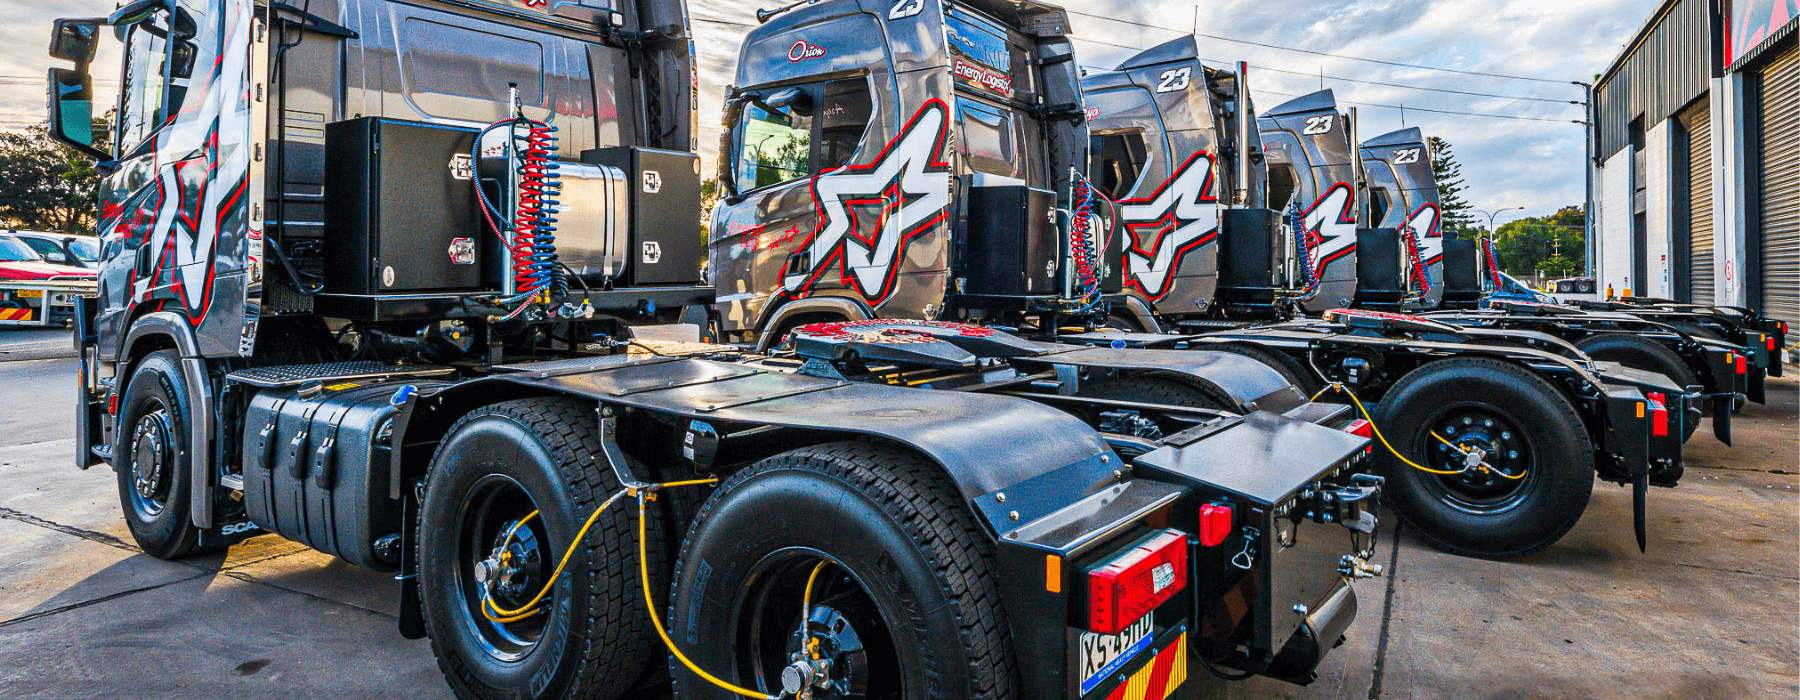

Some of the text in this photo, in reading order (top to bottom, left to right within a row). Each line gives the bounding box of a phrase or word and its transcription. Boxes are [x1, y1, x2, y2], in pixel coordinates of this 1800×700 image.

[888, 0, 924, 20] 23
[788, 39, 827, 63] Orion
[1157, 67, 1192, 94] 23
[1303, 115, 1333, 136] 23
[1393, 148, 1420, 165] 23
[728, 221, 767, 237] Energy
